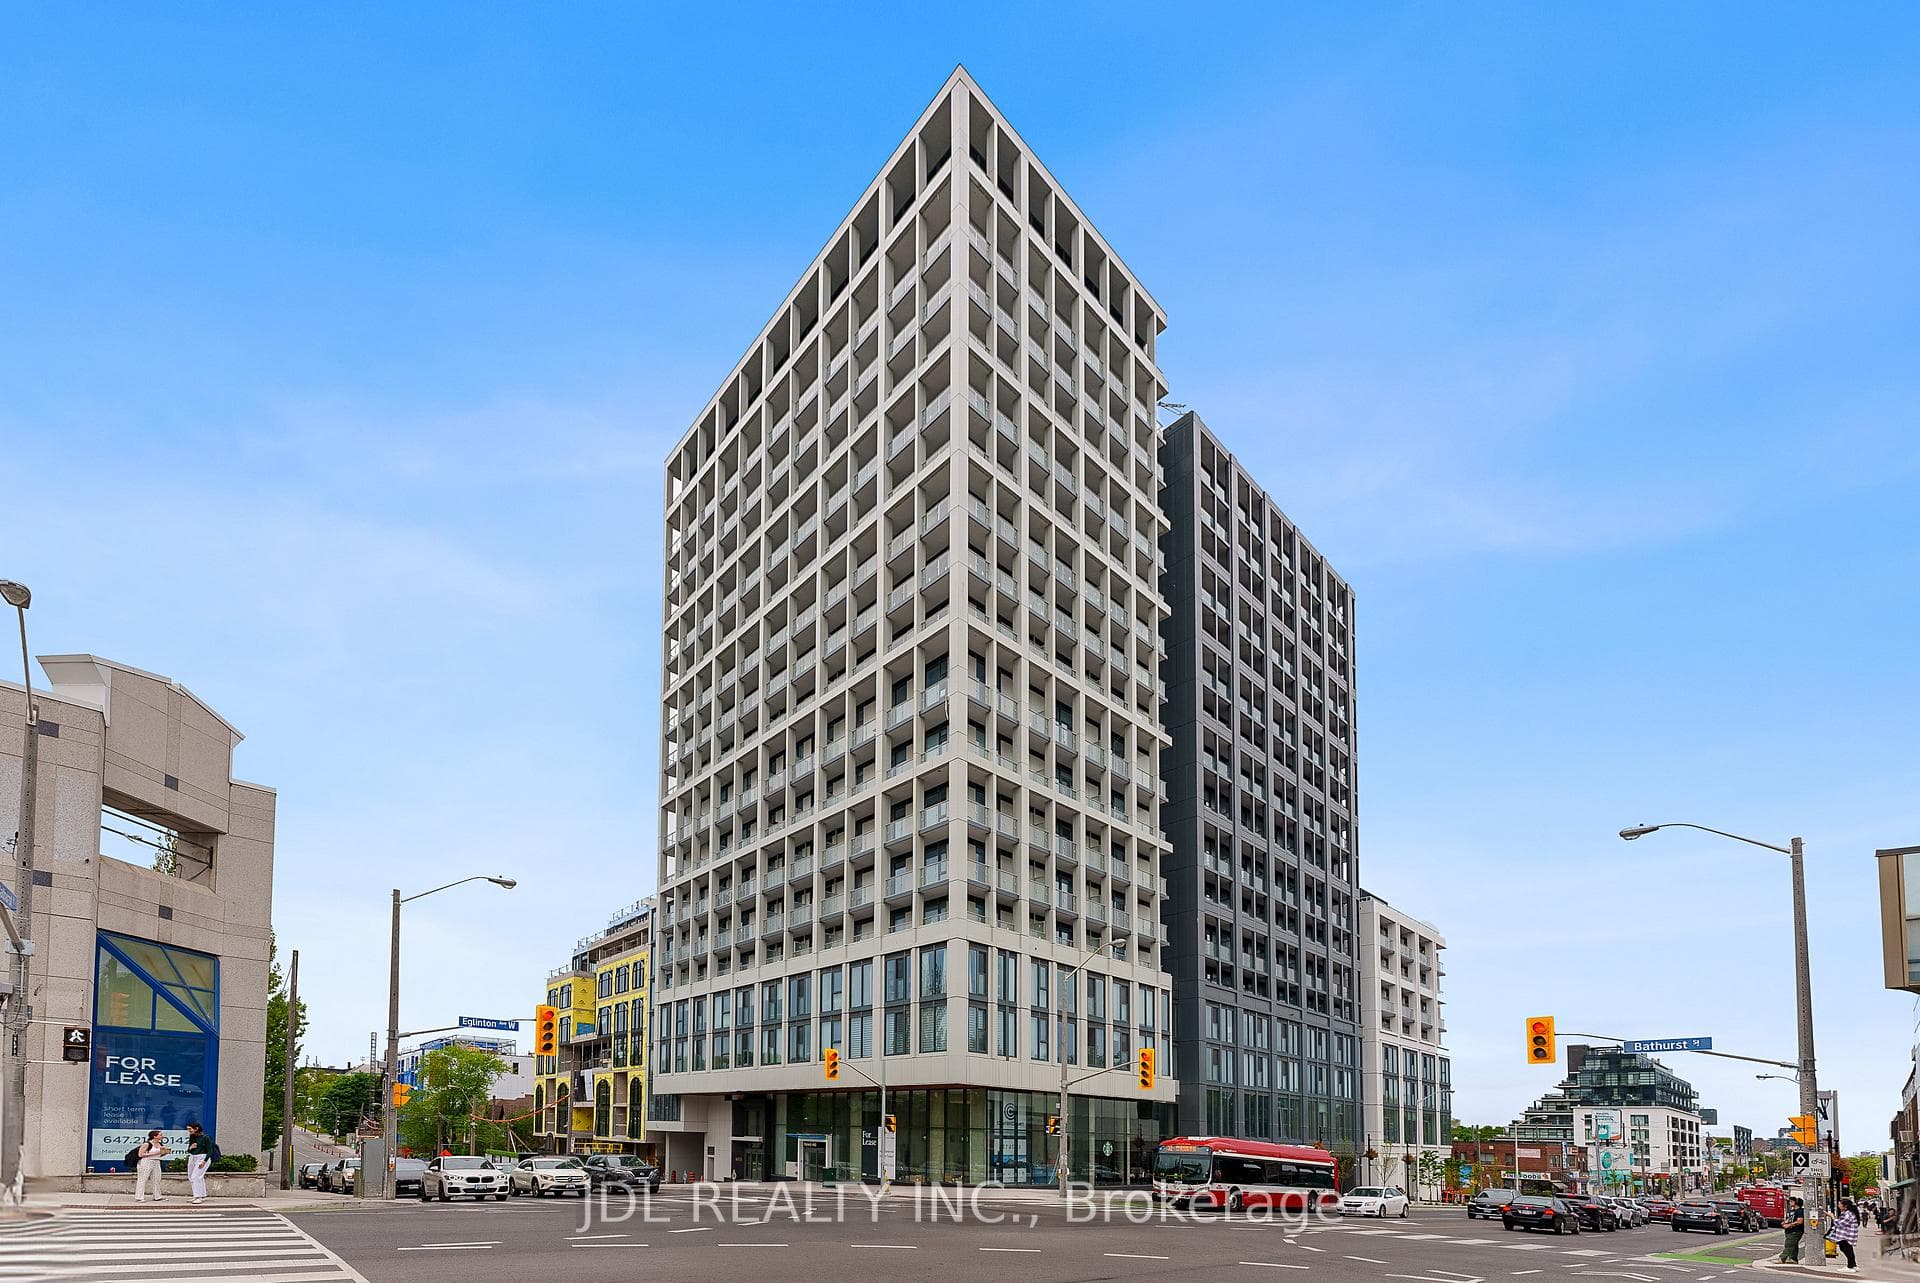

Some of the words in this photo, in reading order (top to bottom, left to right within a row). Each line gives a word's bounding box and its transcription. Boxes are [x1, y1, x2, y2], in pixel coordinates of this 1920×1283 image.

[462, 1017, 497, 1028] Eglinton
[508, 1021, 516, 1030] W
[1634, 1040, 1688, 1051] Bathurst
[105, 1055, 156, 1071] FOR
[105, 1071, 182, 1087] LEASE
[862, 1130, 872, 1138] For
[862, 1138, 877, 1146] Lease
